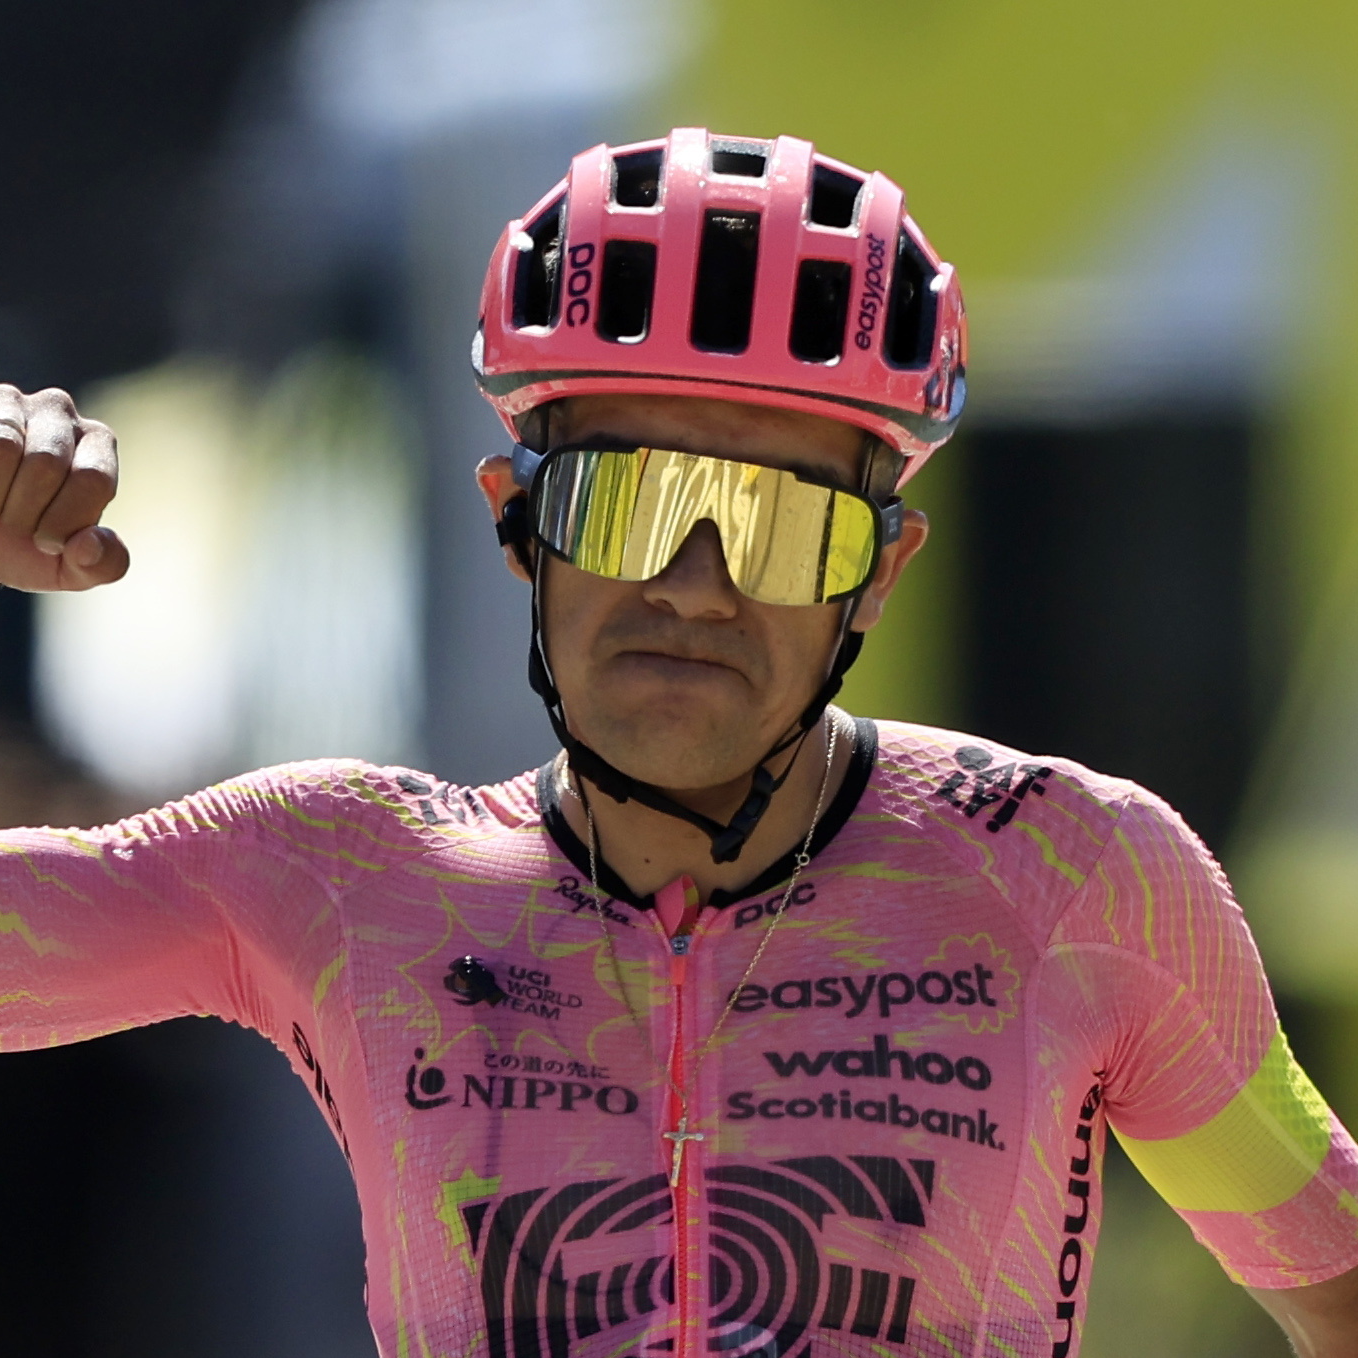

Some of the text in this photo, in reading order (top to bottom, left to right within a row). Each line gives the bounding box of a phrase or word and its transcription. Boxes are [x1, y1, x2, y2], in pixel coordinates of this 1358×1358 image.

[854, 232, 886, 351] easypost
[506, 979, 583, 1009] WORLD
[508, 965, 551, 987] UCI
[727, 963, 997, 1019] easypost
[501, 996, 561, 1021] TEAM
[762, 1034, 992, 1091] wahoo
[462, 1073, 639, 1115] NIPPO
